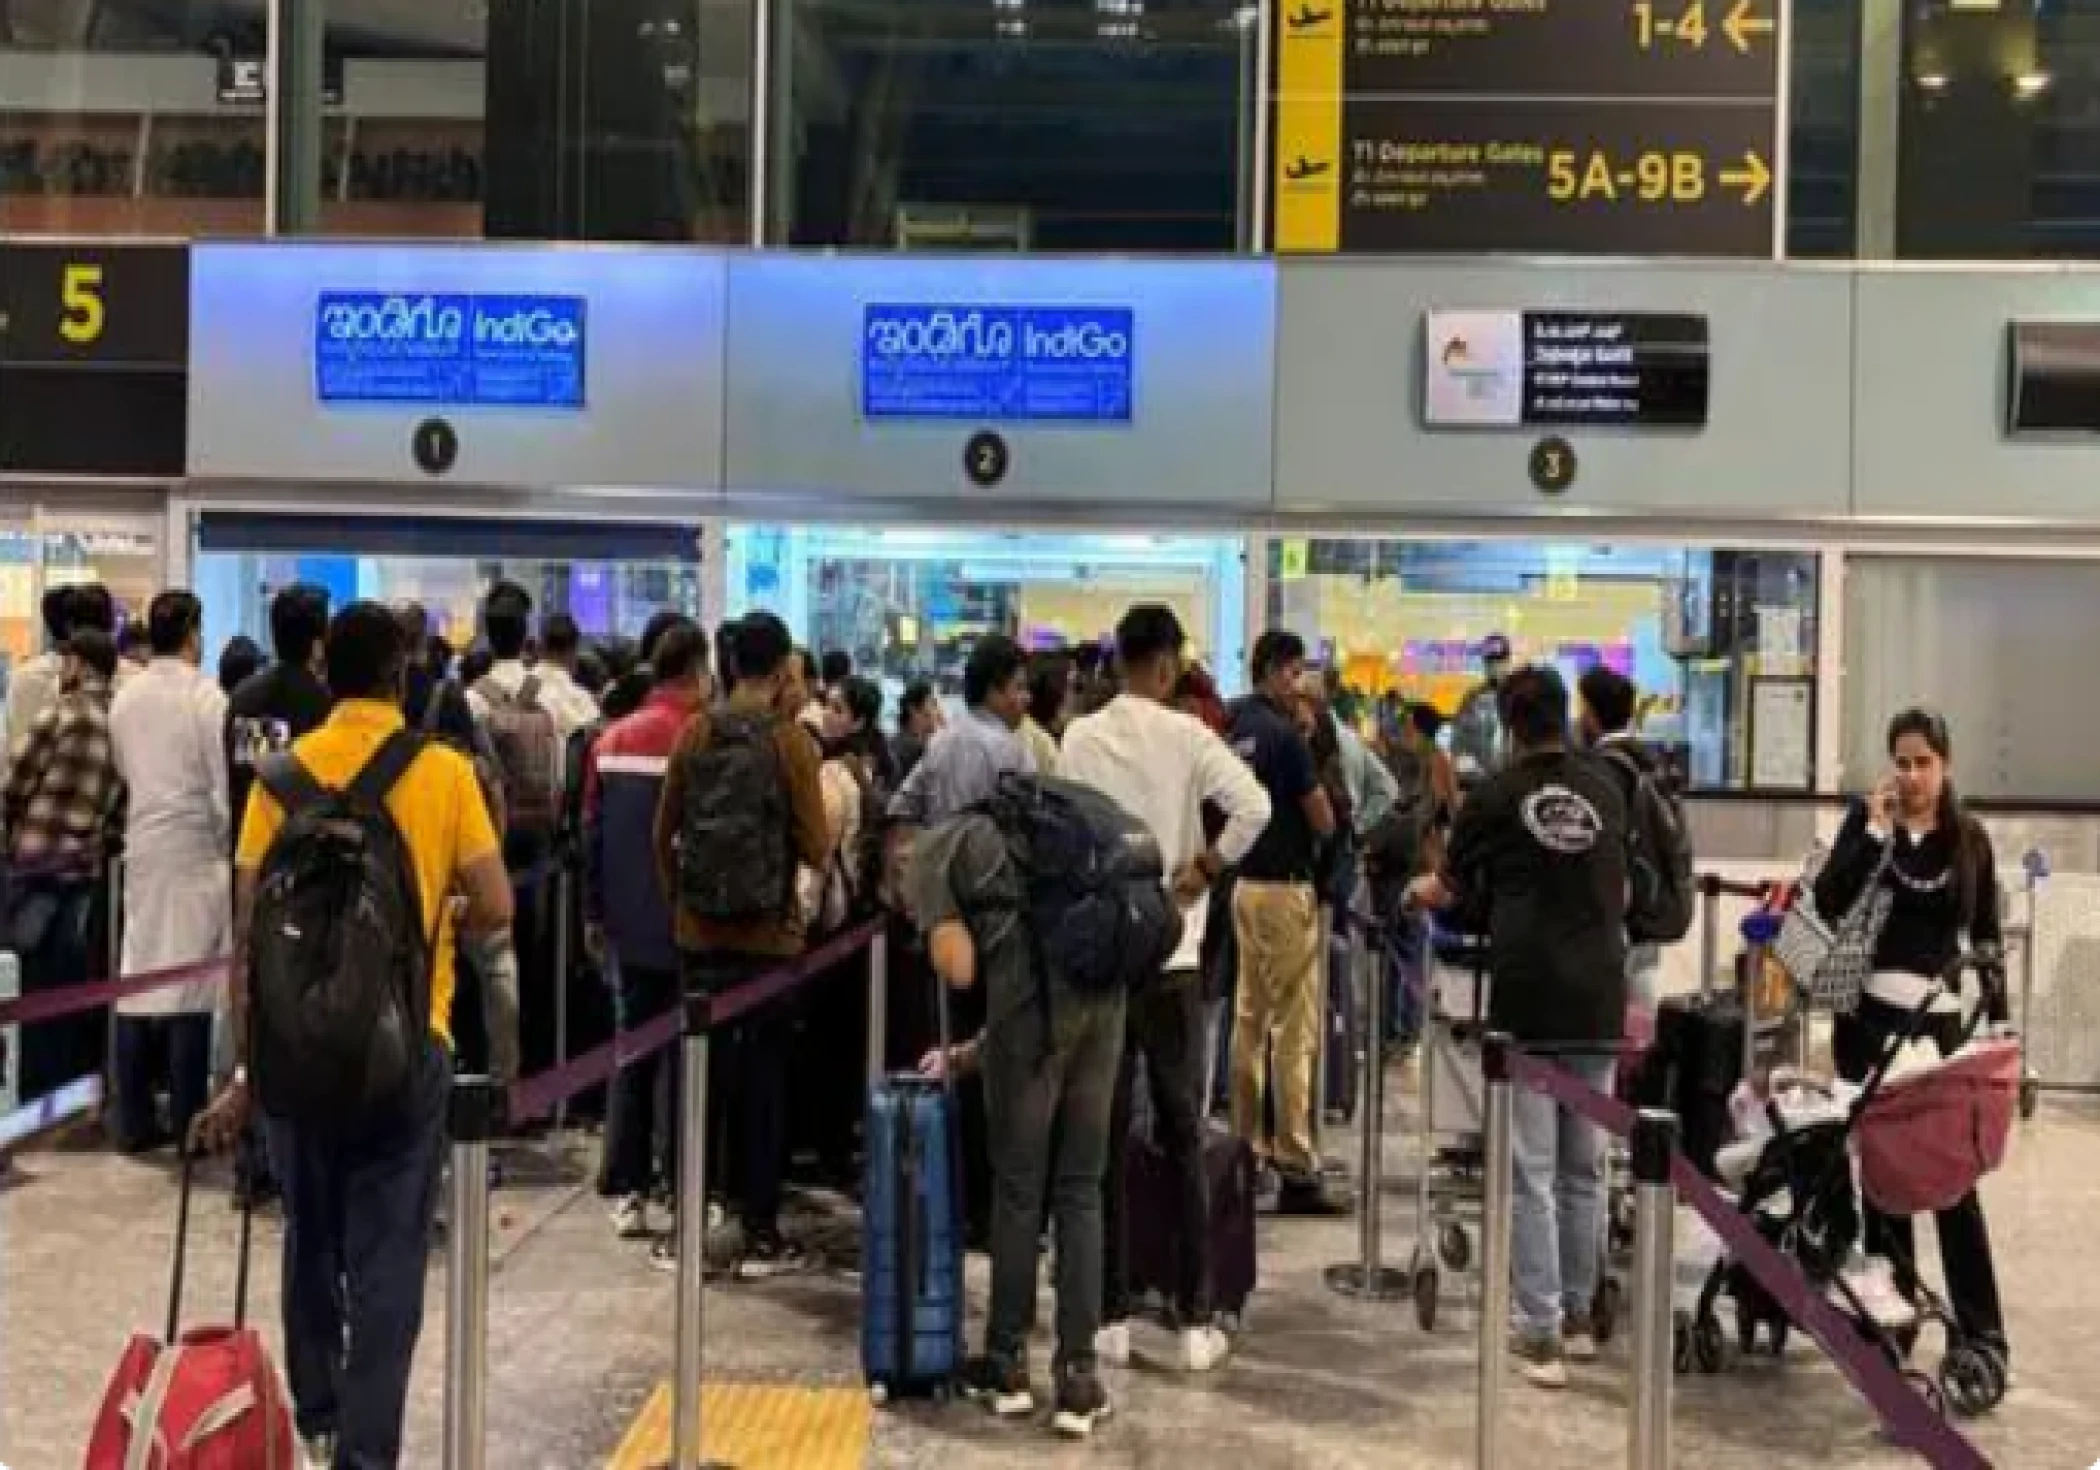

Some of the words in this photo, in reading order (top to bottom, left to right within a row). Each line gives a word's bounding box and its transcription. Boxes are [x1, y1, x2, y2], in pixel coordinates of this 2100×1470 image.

[1633, 3, 1707, 48] 1-4
[1379, 141, 1479, 165] Departure
[1485, 141, 1544, 165] Gates
[1547, 151, 1704, 200] 5A-9B
[59, 264, 104, 341] 5
[474, 310, 577, 344] IndiGo
[1023, 321, 1127, 358] IndiGo
[429, 432, 441, 460] 1
[975, 445, 997, 473] 2
[1545, 452, 1561, 478] 3
